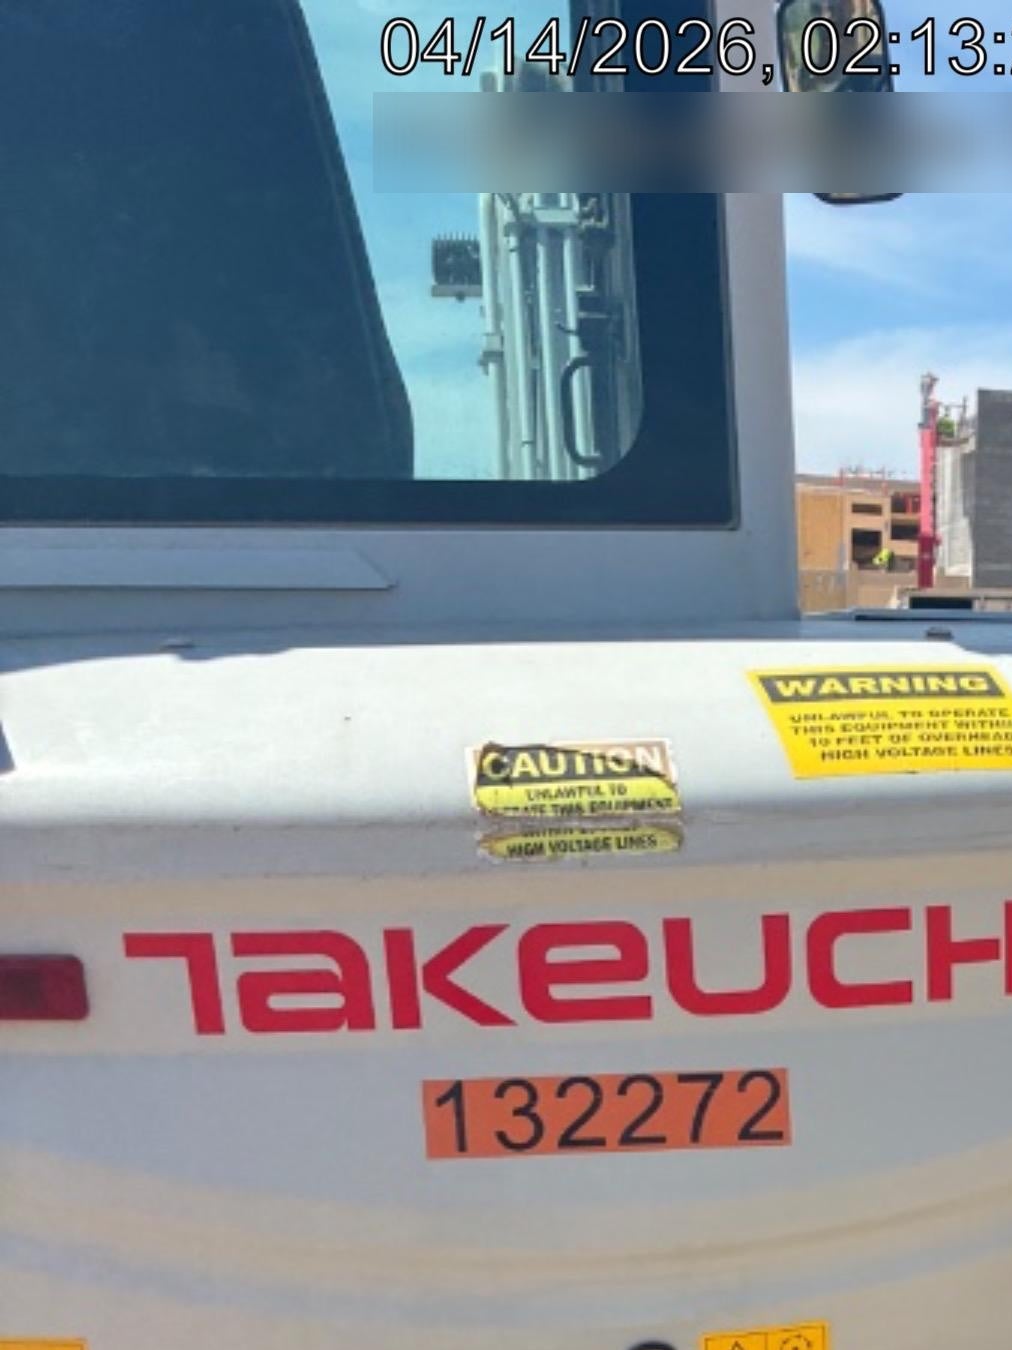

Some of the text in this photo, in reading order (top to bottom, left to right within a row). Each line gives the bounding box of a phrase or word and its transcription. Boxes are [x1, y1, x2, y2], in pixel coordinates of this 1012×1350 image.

[775, 675, 990, 698] WARNING
[790, 707, 1010, 723] UNLAWFUL TO OPERATE
[791, 724, 835, 735] THIS
[840, 720, 948, 734] EQUIPMENT
[810, 736, 830, 748] 10
[835, 734, 882, 746] FEET
[889, 733, 911, 745] OF
[481, 746, 664, 780] CAUTION
[821, 748, 870, 761] HIGH
[875, 745, 959, 760] VOLTAGE
[526, 781, 628, 802] UNLAWFUL TO
[506, 834, 658, 858] HIGH VOLTAGE LINES
[435, 1070, 785, 1153] 132272
